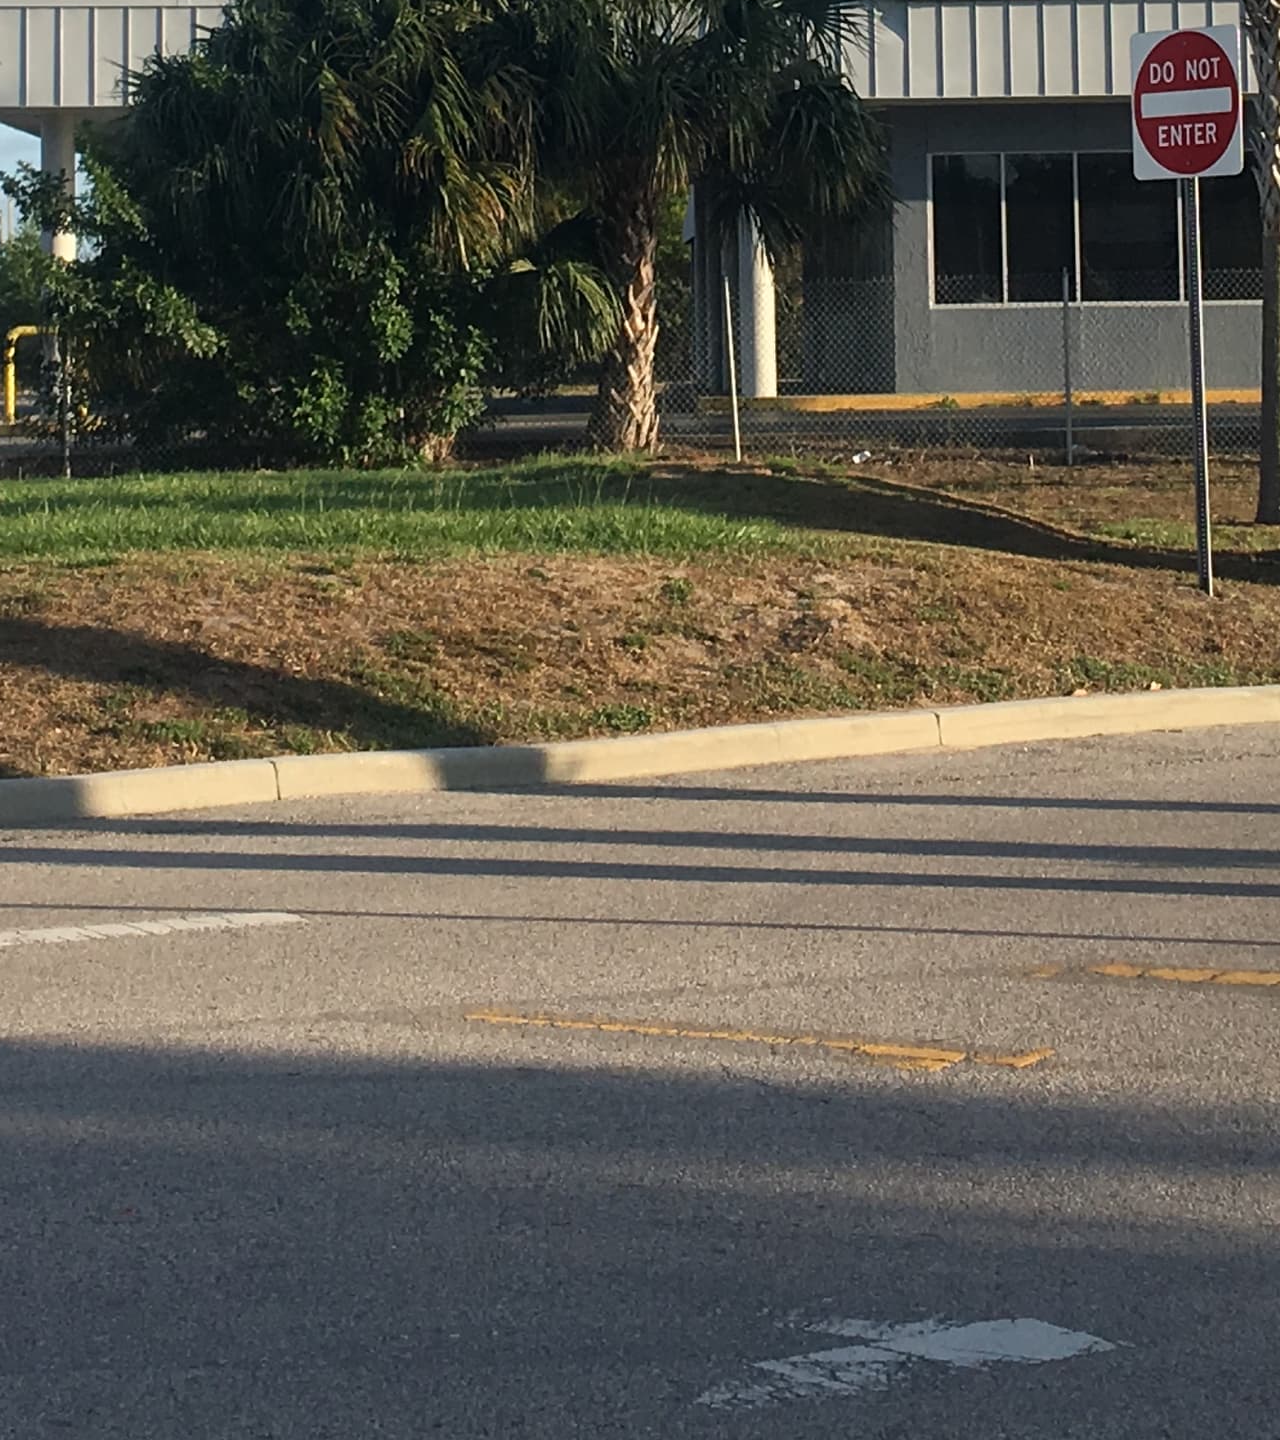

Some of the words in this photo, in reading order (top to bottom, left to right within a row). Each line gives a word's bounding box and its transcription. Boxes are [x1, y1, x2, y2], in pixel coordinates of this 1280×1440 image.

[1149, 61, 1175, 85] DO
[1185, 57, 1221, 82] NOT
[1157, 122, 1218, 148] ENTER
